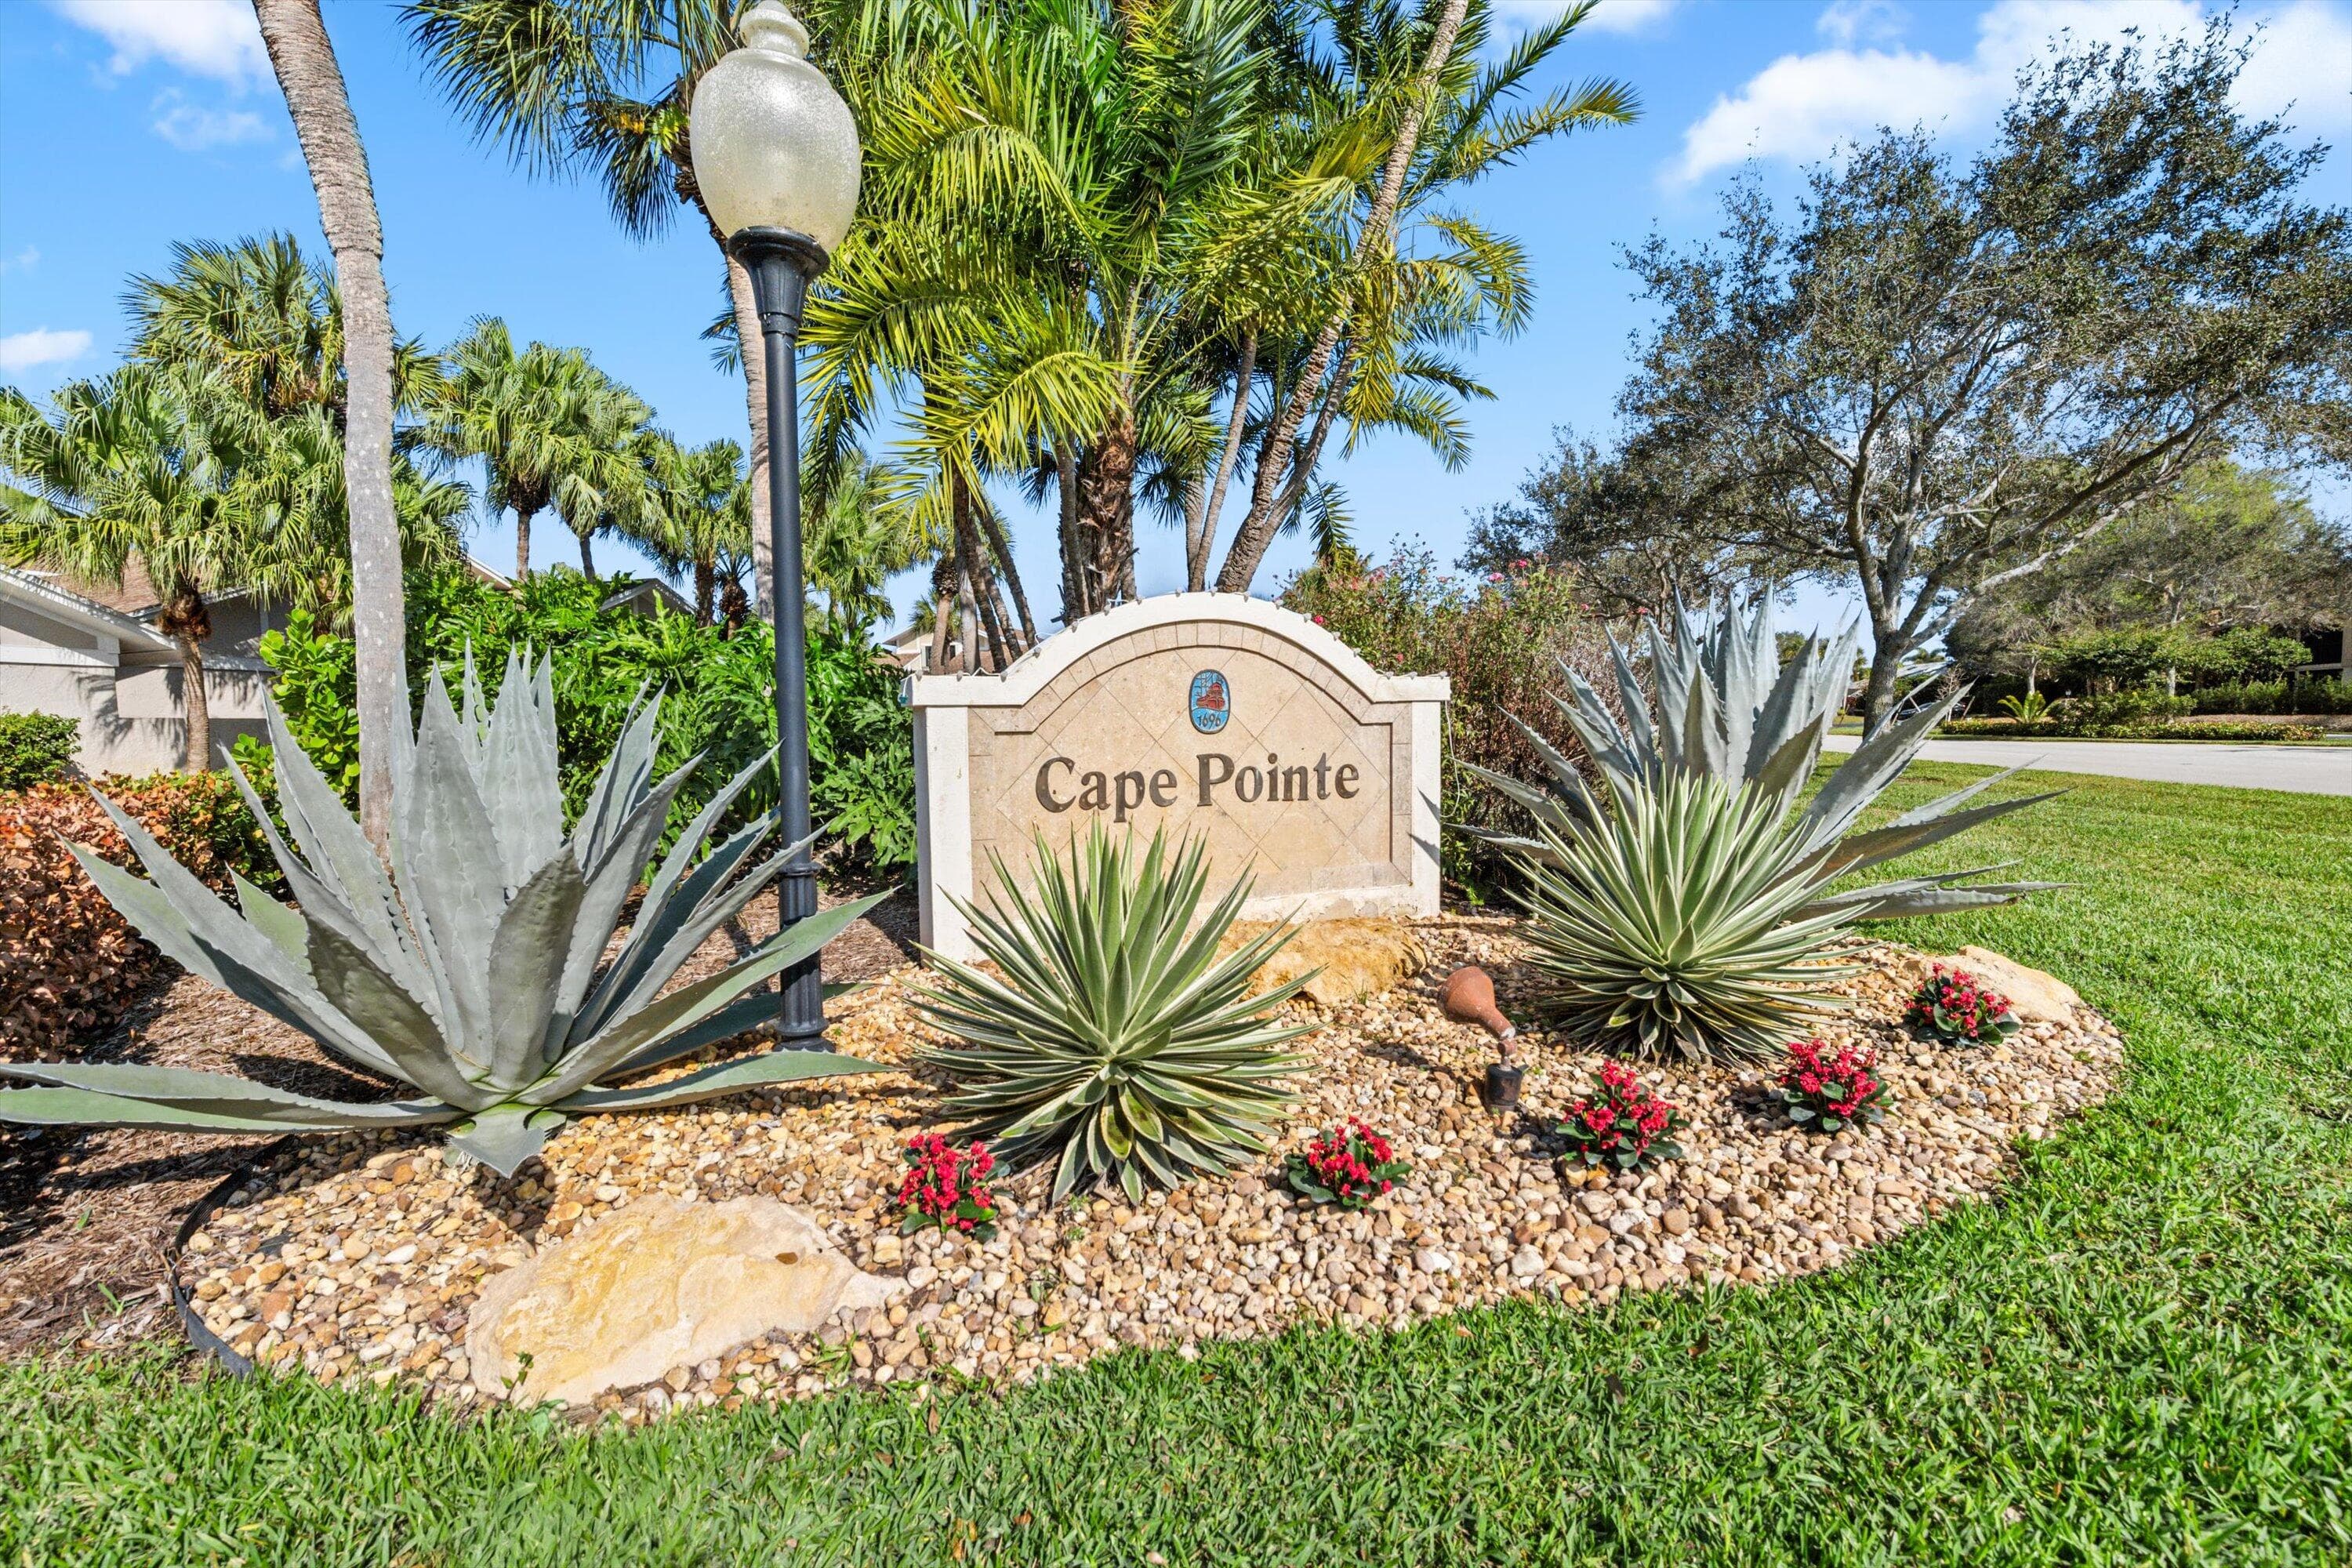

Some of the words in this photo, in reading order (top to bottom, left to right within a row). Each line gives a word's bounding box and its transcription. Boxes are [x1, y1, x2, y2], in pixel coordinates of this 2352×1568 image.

[1196, 712, 1221, 730] 1696
[1035, 757, 1178, 823] Cape
[1196, 752, 1360, 808] Pointe
